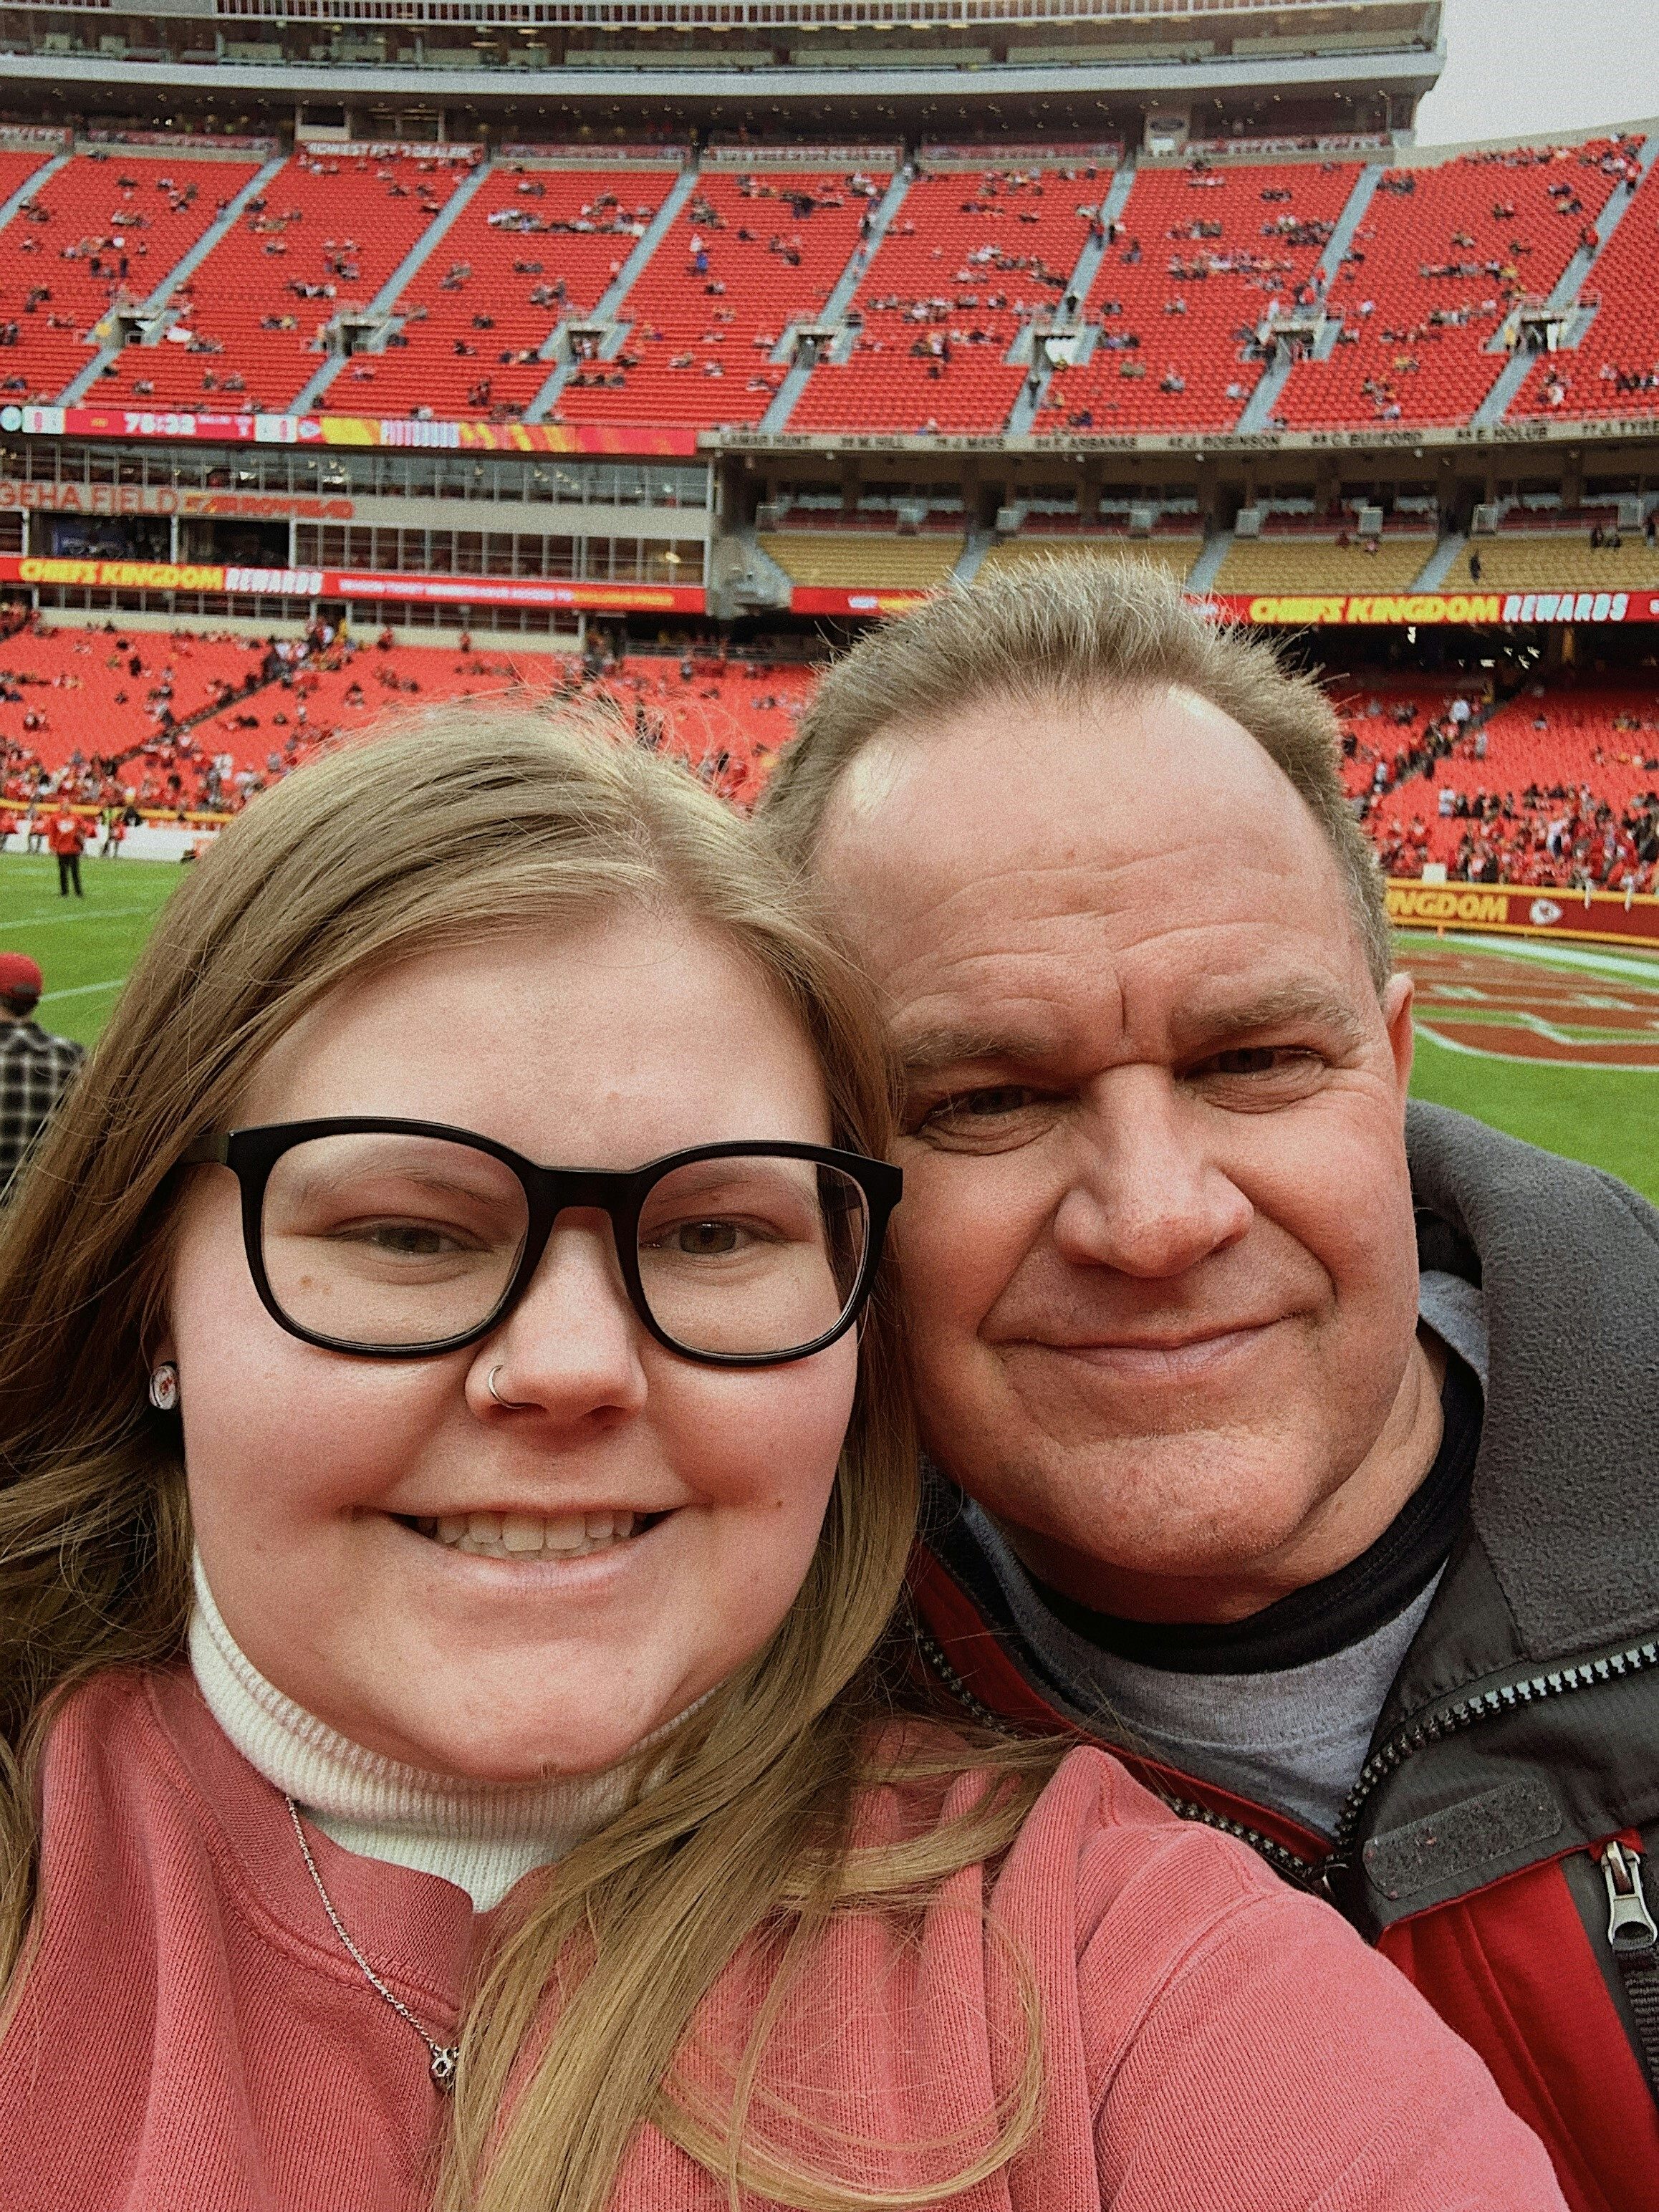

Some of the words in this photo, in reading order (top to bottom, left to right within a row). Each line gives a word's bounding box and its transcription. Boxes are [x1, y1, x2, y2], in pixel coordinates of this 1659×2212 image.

[0, 481, 82, 510] GEHA
[92, 485, 178, 515] FIELD
[100, 562, 223, 590] KINGDOM
[1346, 595, 1500, 623] KINGDOM
[1502, 593, 1629, 622] REWARDS
